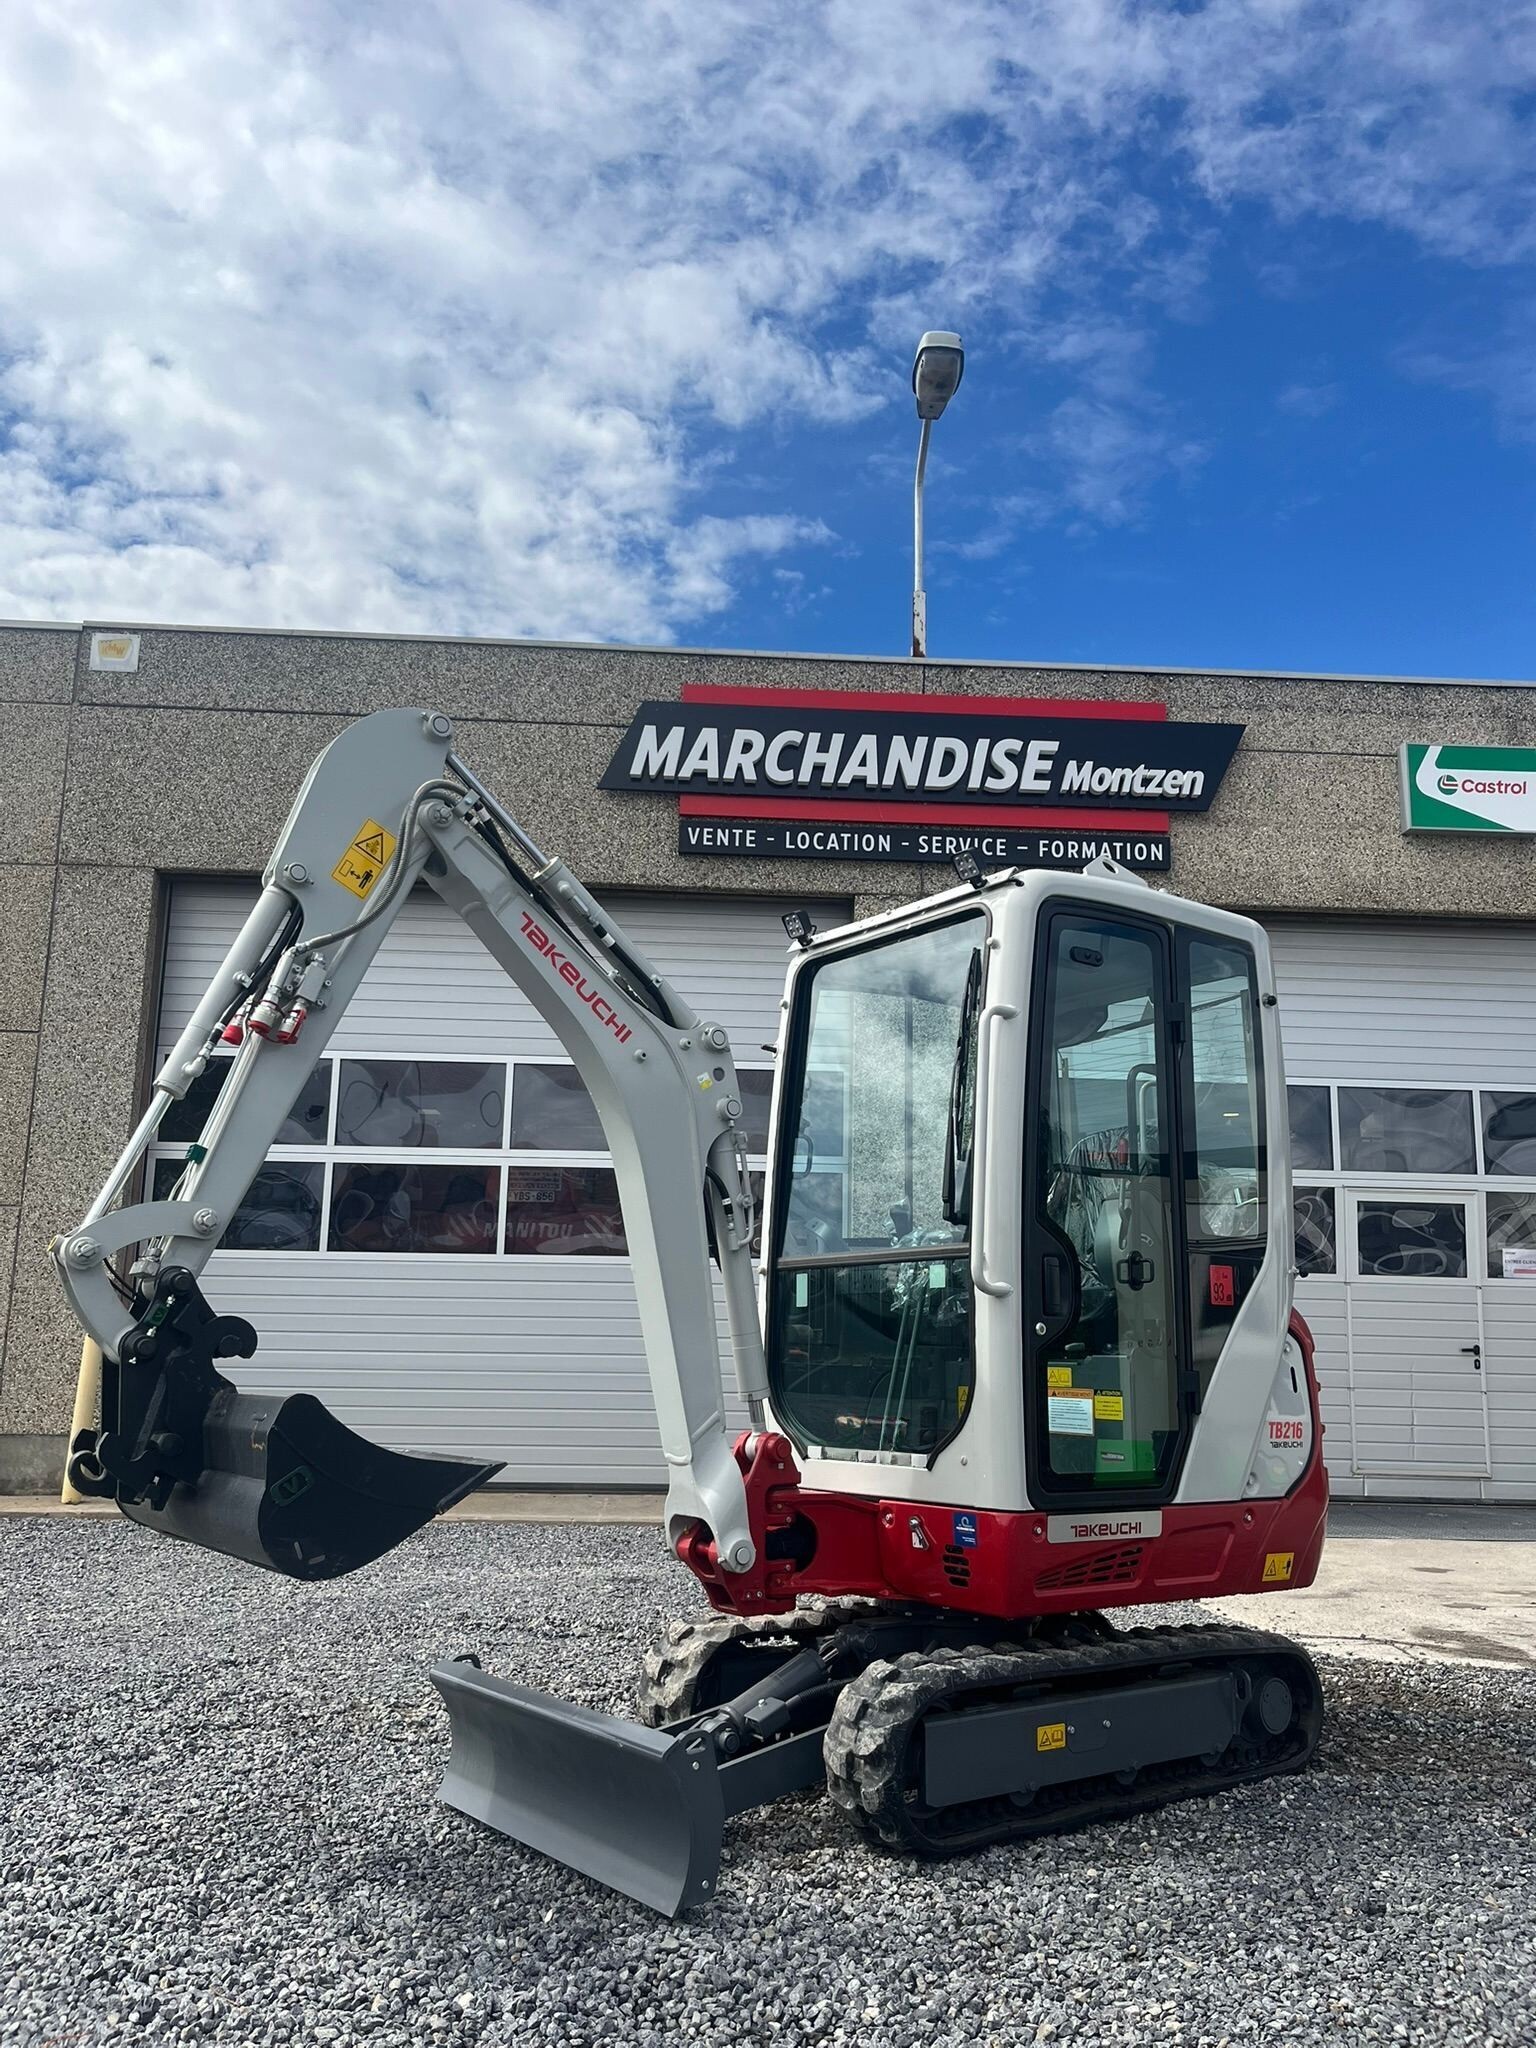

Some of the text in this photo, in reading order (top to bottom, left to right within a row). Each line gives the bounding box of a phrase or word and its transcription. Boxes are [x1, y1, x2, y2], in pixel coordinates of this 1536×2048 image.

[629, 724, 1205, 798] MARCHANDISE Montzen
[1461, 779, 1527, 795] Castrol
[687, 827, 757, 848] VENTE
[785, 831, 892, 852] LOCATION
[1038, 840, 1164, 861] FORMATION
[1213, 1282, 1225, 1302] 93
[1268, 1421, 1303, 1439] TB216
